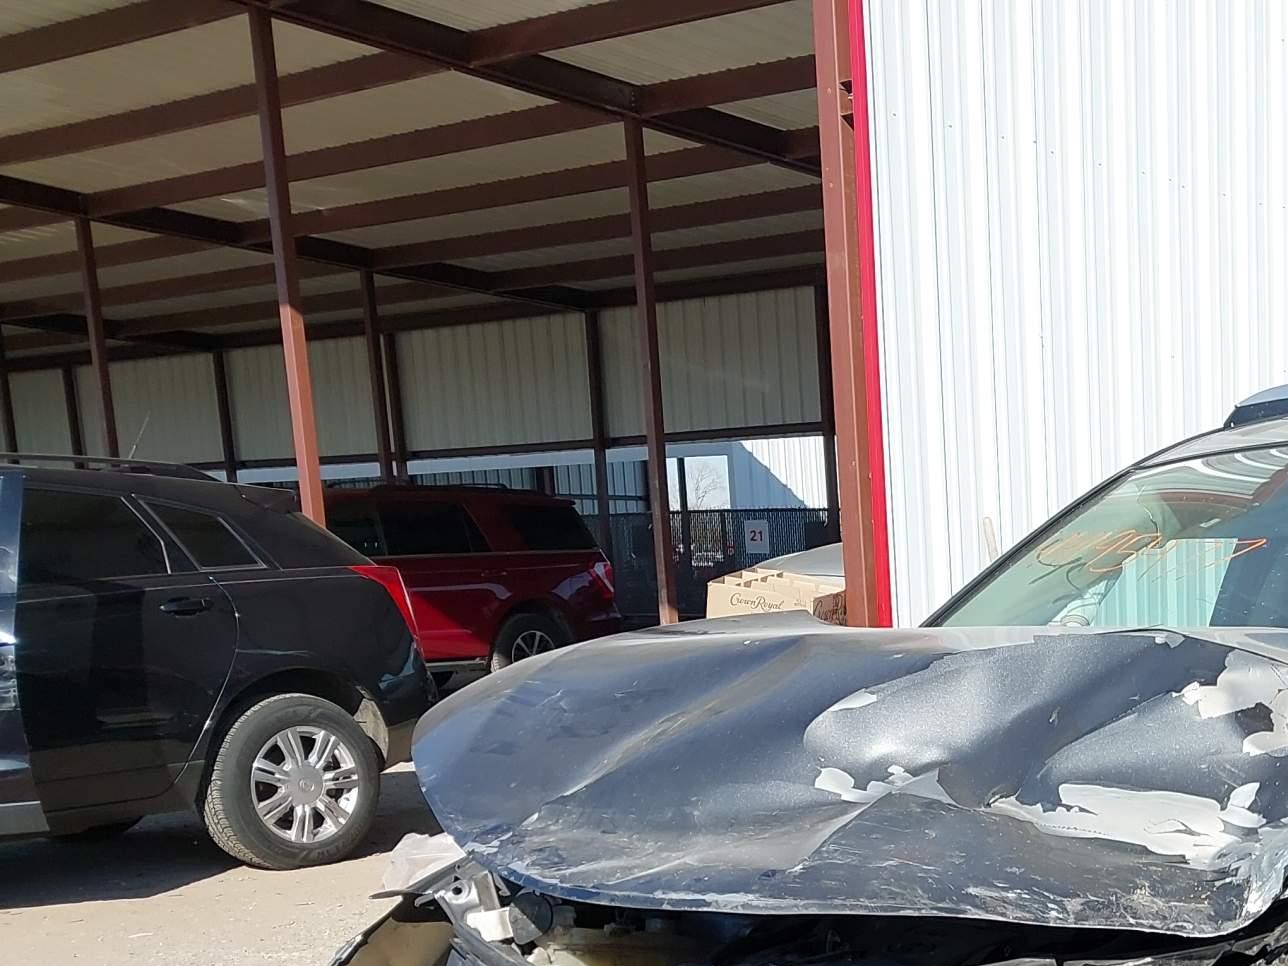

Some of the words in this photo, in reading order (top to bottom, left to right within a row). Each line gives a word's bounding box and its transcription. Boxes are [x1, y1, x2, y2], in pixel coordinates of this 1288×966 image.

[749, 529, 763, 542] 21
[729, 592, 756, 607] Crown
[754, 595, 785, 613] Royal
